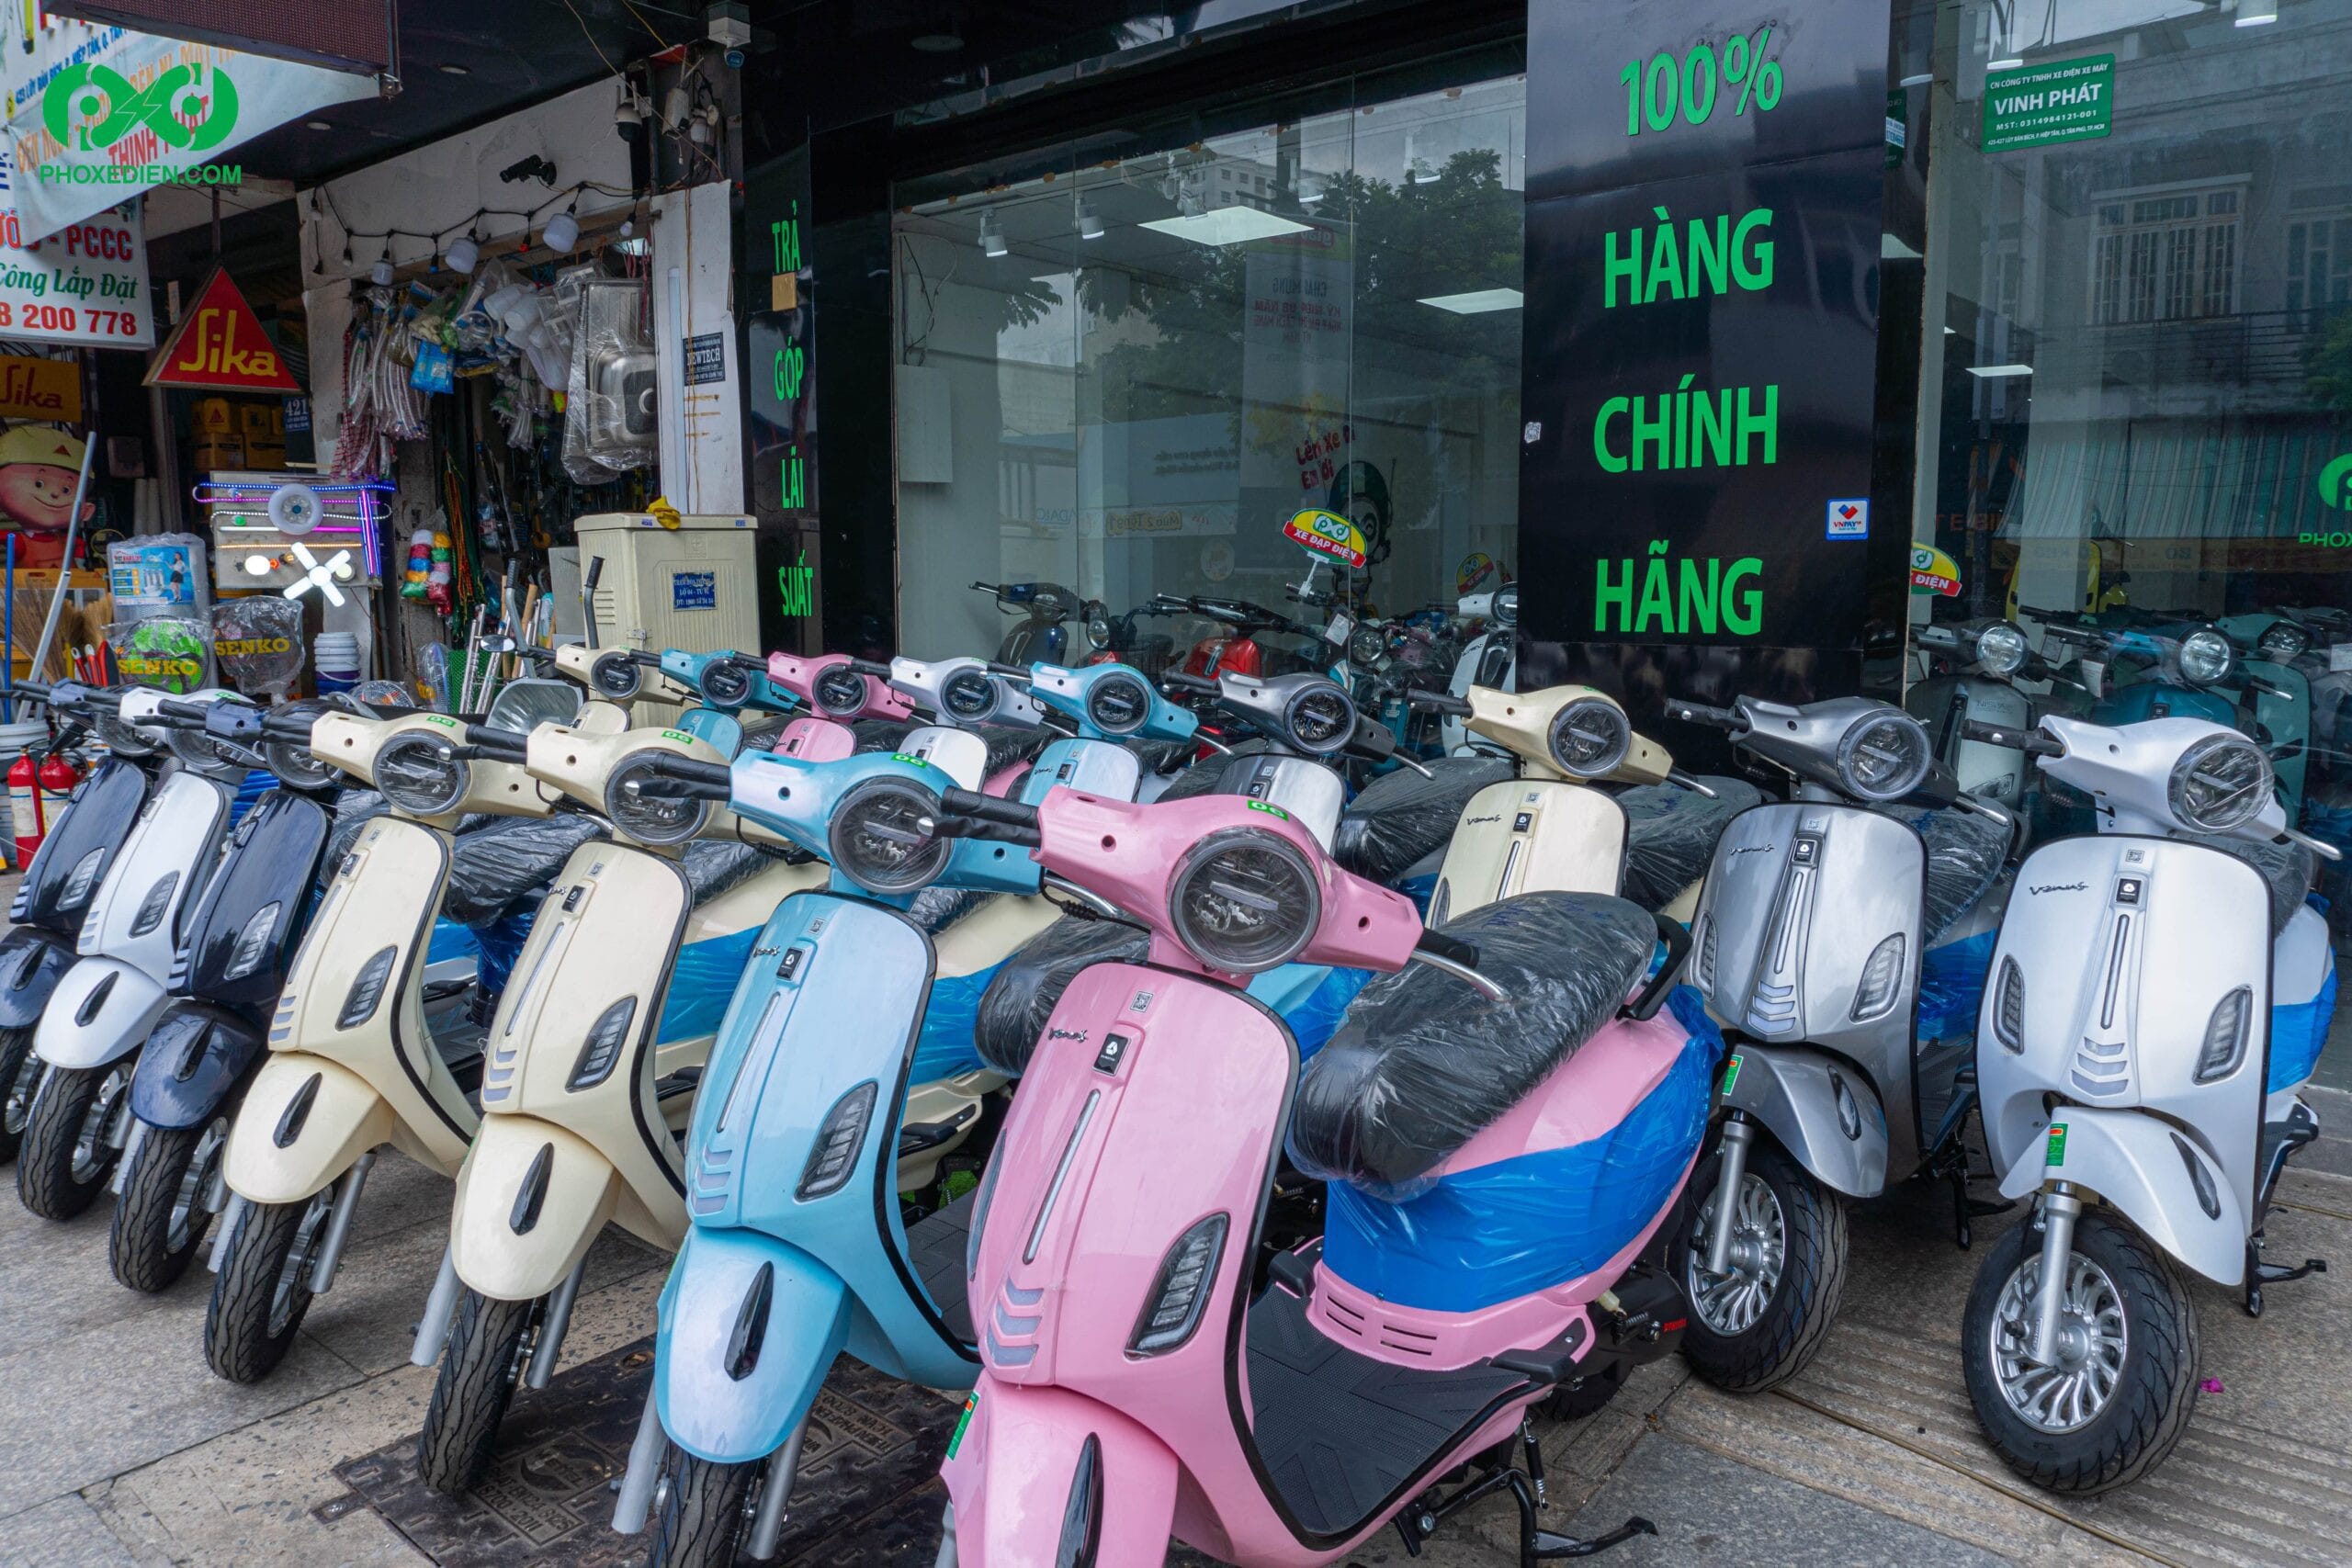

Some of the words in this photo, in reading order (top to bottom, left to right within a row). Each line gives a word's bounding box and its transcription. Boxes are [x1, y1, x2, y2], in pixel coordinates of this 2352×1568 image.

[1619, 28, 1784, 137] 100%
[2000, 77, 2020, 88] CÔNG
[2021, 76, 2030, 85] TY
[2031, 73, 2052, 83] TNHH
[2052, 71, 2062, 79] XE
[2063, 67, 2080, 77] ĐIỆN
[2081, 65, 2090, 73] XE
[2092, 63, 2109, 72] MÁY
[1994, 93, 2043, 116] VINH
[2049, 82, 2102, 107] PHÁT
[1996, 121, 2018, 130] MST:
[65, 222, 133, 263] PCCC
[772, 199, 801, 274] TRẢ
[1605, 207, 1774, 309] HÀNG
[53, 265, 95, 300] Lắp
[100, 274, 138, 304] Đặt
[22, 303, 76, 332] 200
[85, 309, 137, 336] 778
[179, 308, 277, 378] Sika
[0, 364, 63, 411] Sika
[774, 336, 805, 401] GÓP
[286, 398, 309, 417] 421
[1593, 374, 1779, 473] CHÍNH
[781, 446, 805, 509] LÃI
[1294, 529, 1308, 541] XE
[1309, 535, 1331, 549] ĐẠP
[1331, 544, 1358, 560] ĐIỆN
[778, 549, 815, 617] SUẤT
[1595, 540, 1764, 637] HÃNG
[1916, 574, 1950, 589] ĐIỆN
[213, 637, 290, 657] SENKO
[117, 659, 198, 677] SENKO
